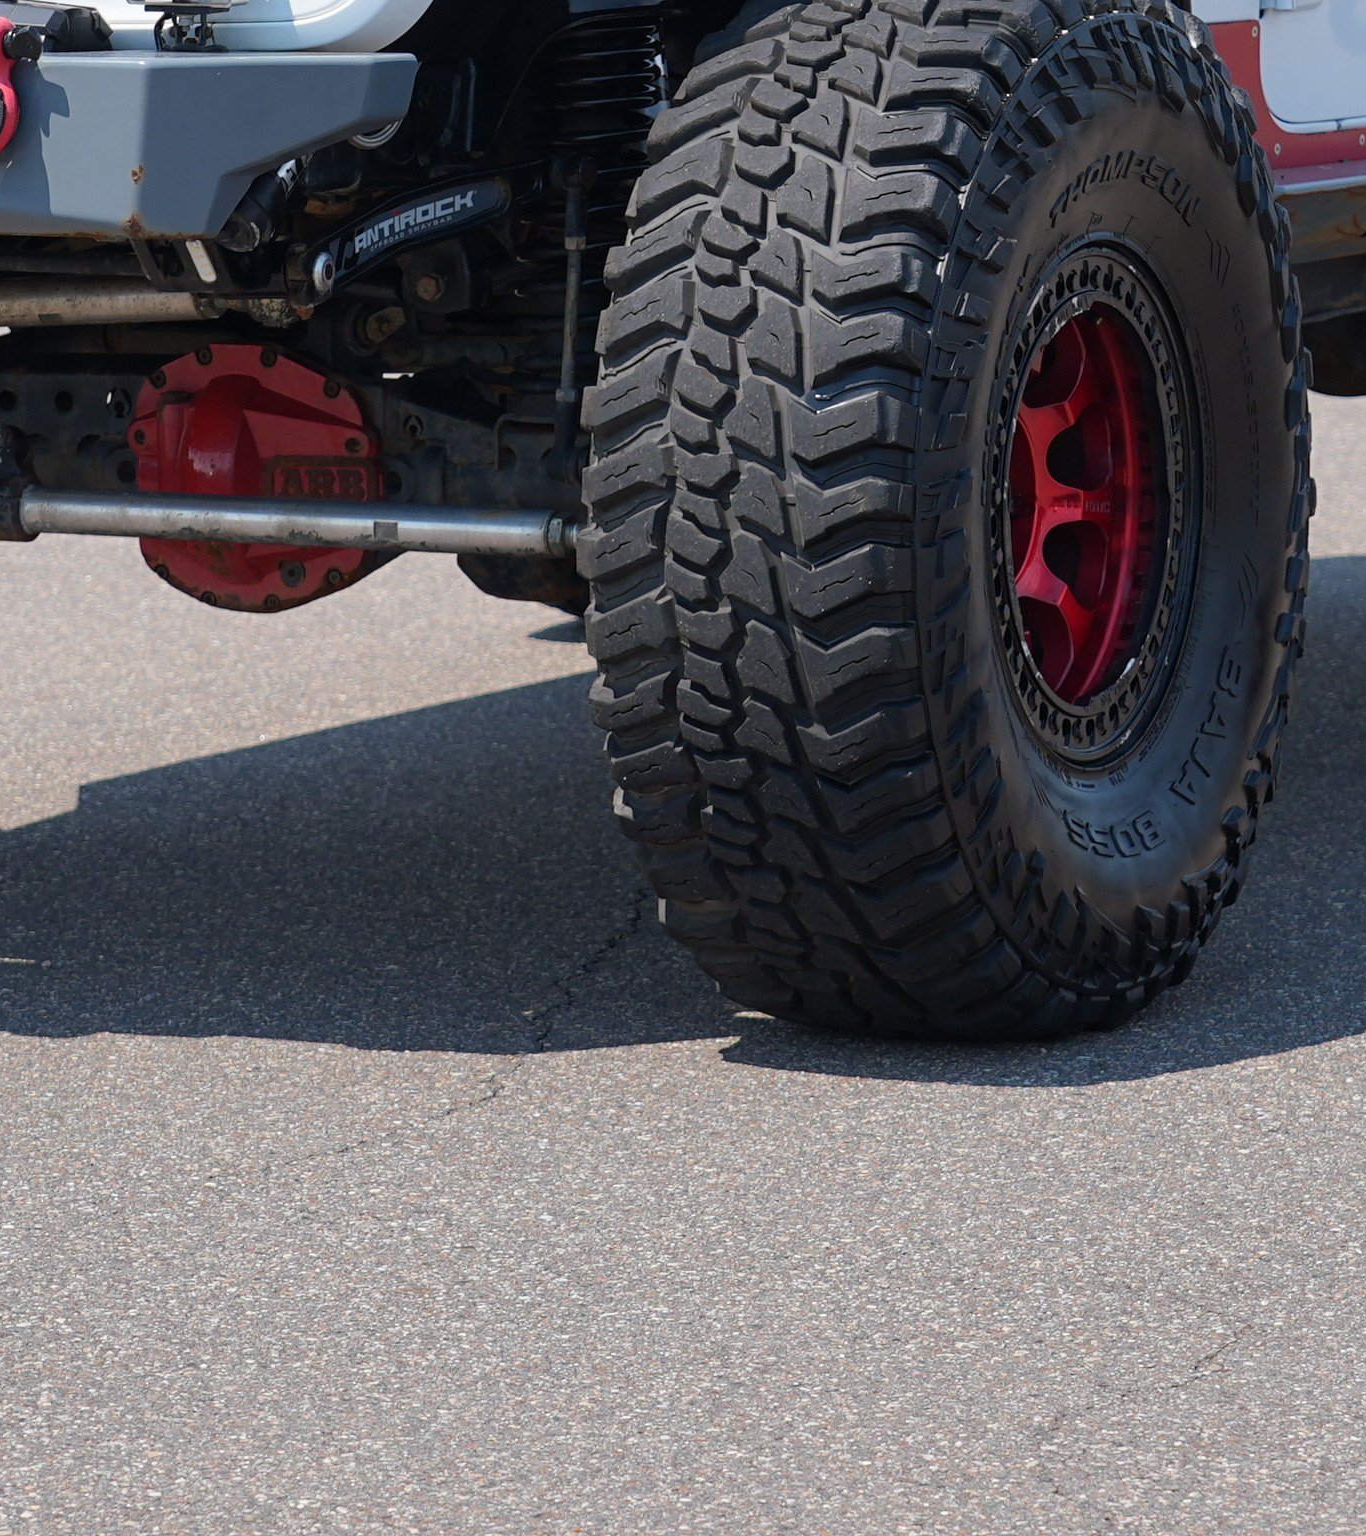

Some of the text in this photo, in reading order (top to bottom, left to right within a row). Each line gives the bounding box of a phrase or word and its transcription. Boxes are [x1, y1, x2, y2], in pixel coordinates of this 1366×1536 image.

[354, 189, 475, 254] ANTIROCK
[1048, 150, 1202, 230] THOMPSON
[275, 466, 367, 499] ARB
[1169, 645, 1242, 806] BAJA
[1062, 809, 1167, 859] BOSS
